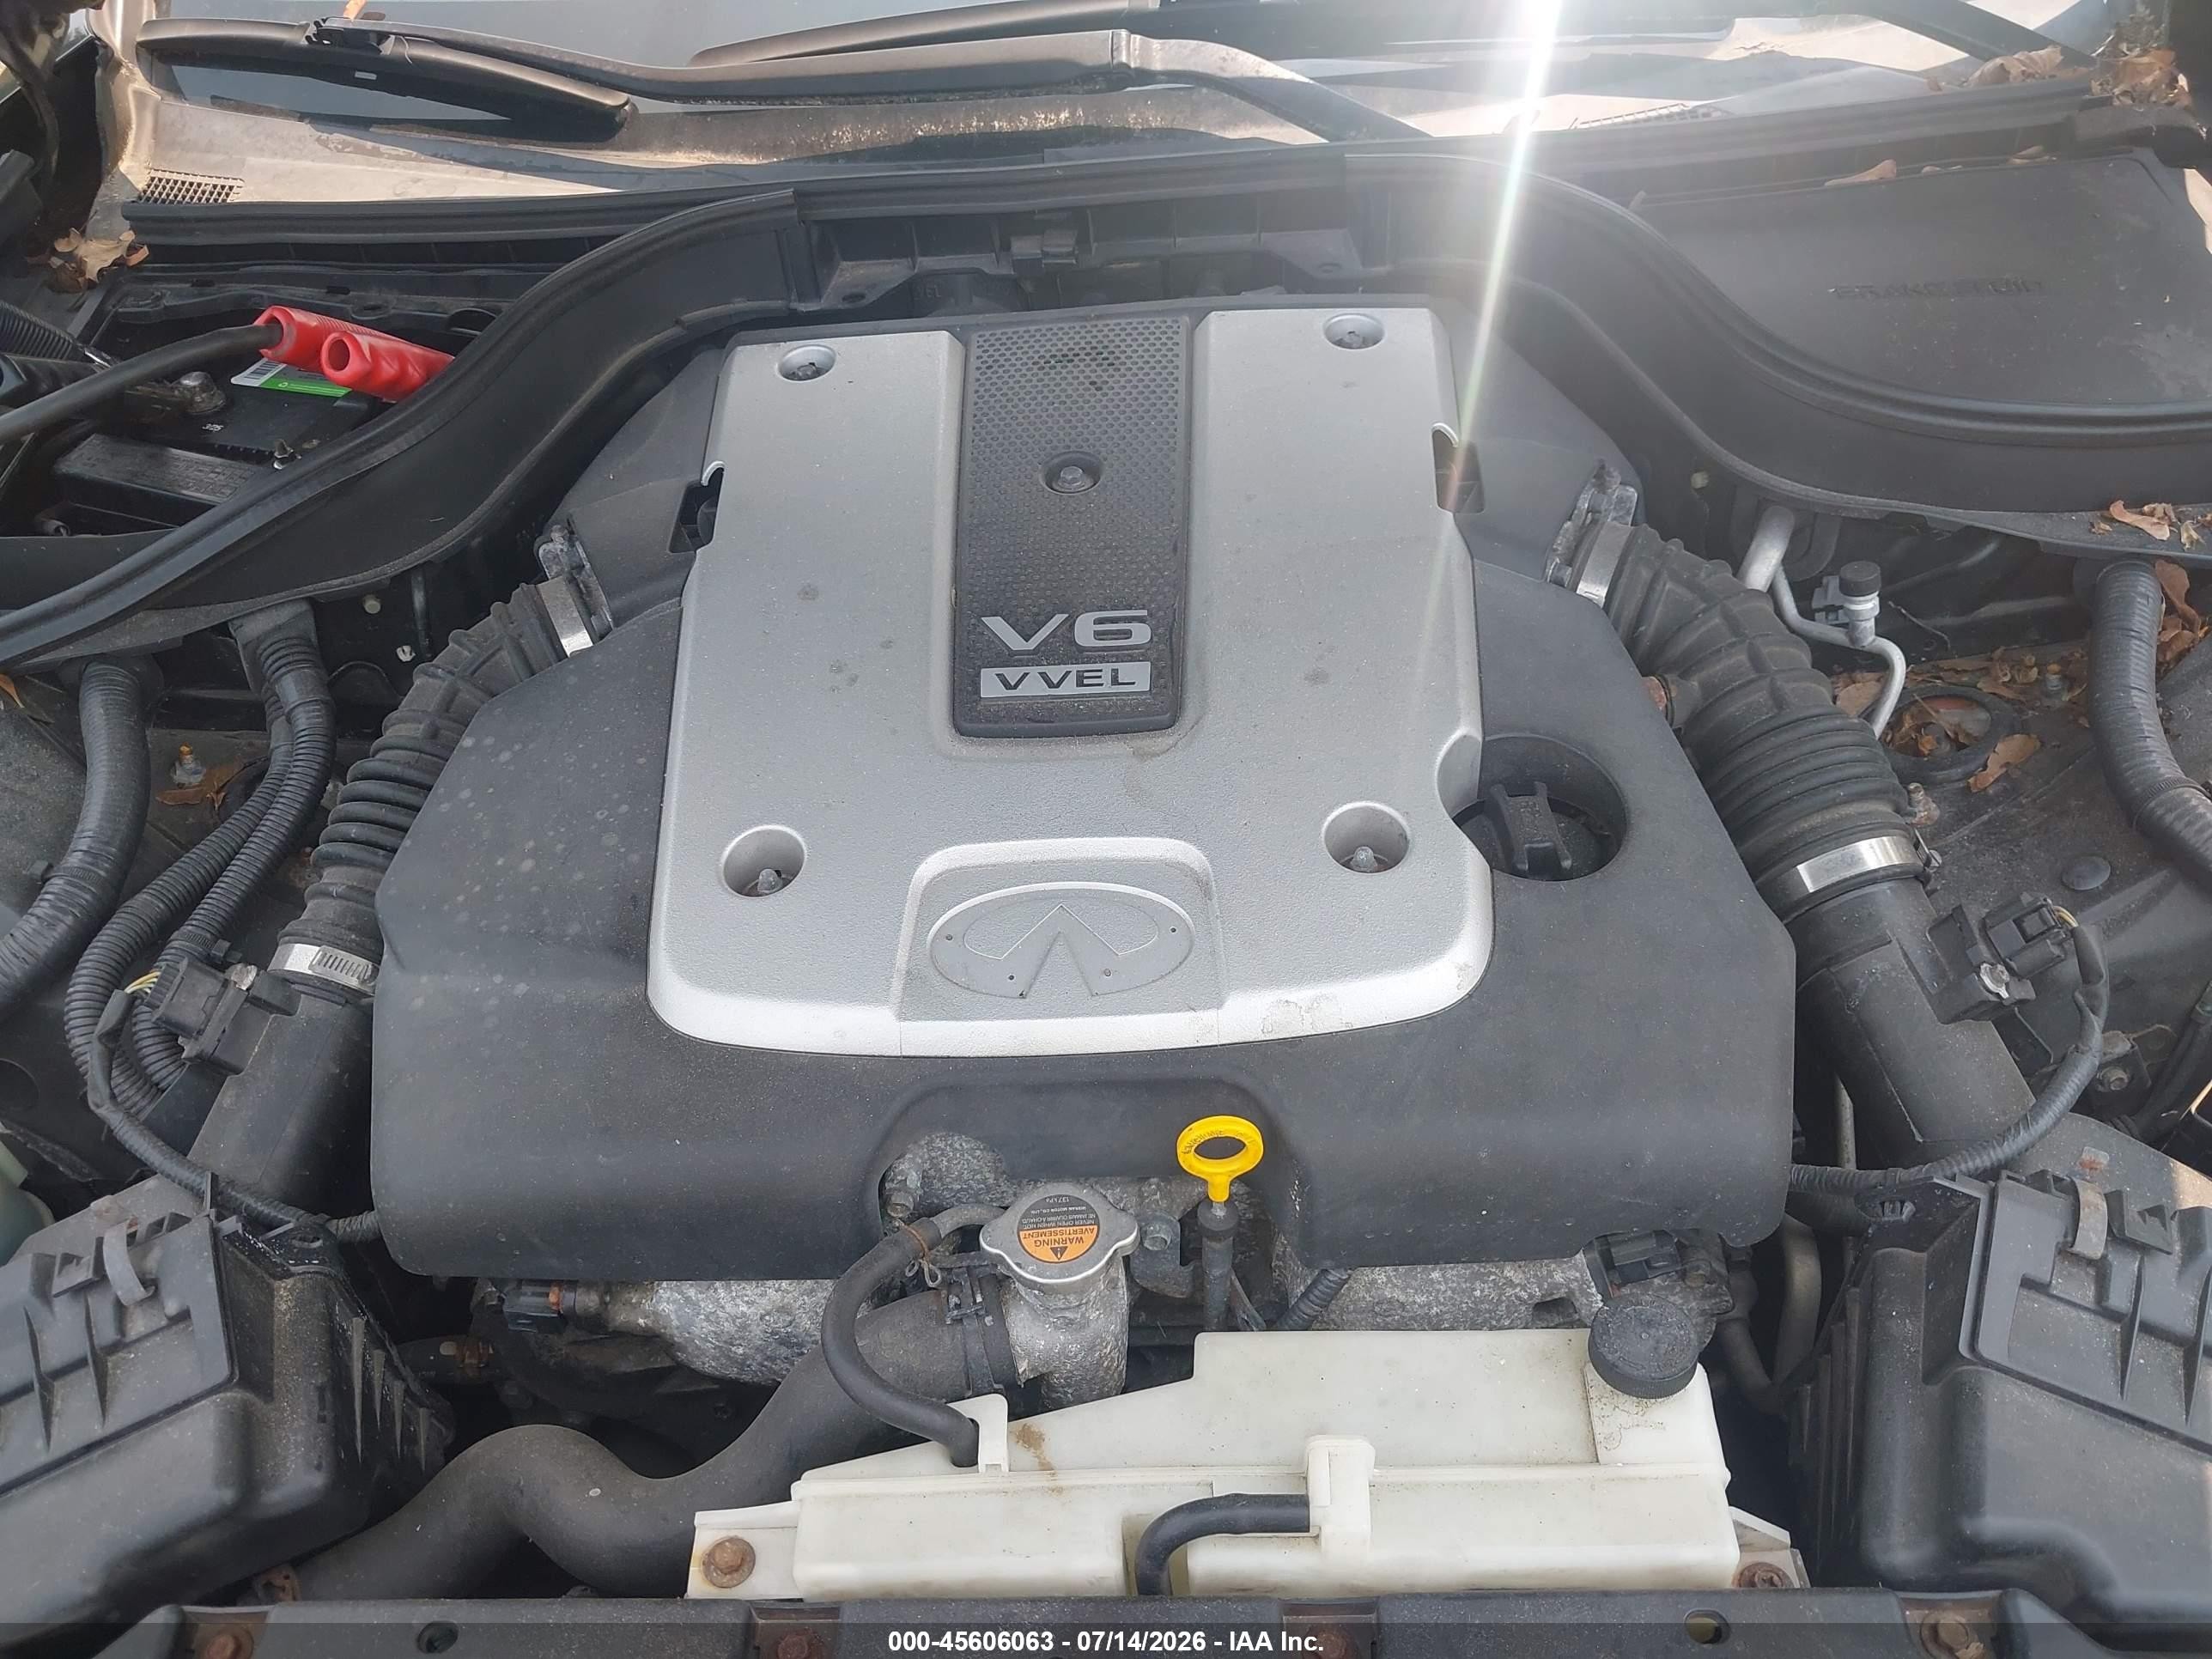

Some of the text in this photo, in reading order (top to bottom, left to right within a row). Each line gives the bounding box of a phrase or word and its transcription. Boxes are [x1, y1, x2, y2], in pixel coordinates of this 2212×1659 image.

[981, 609, 1152, 651] V6
[995, 668, 1136, 690] VVEL
[1023, 1227, 1095, 1239] AVERTISSEMENT
[1034, 1236, 1084, 1248] WARNING
